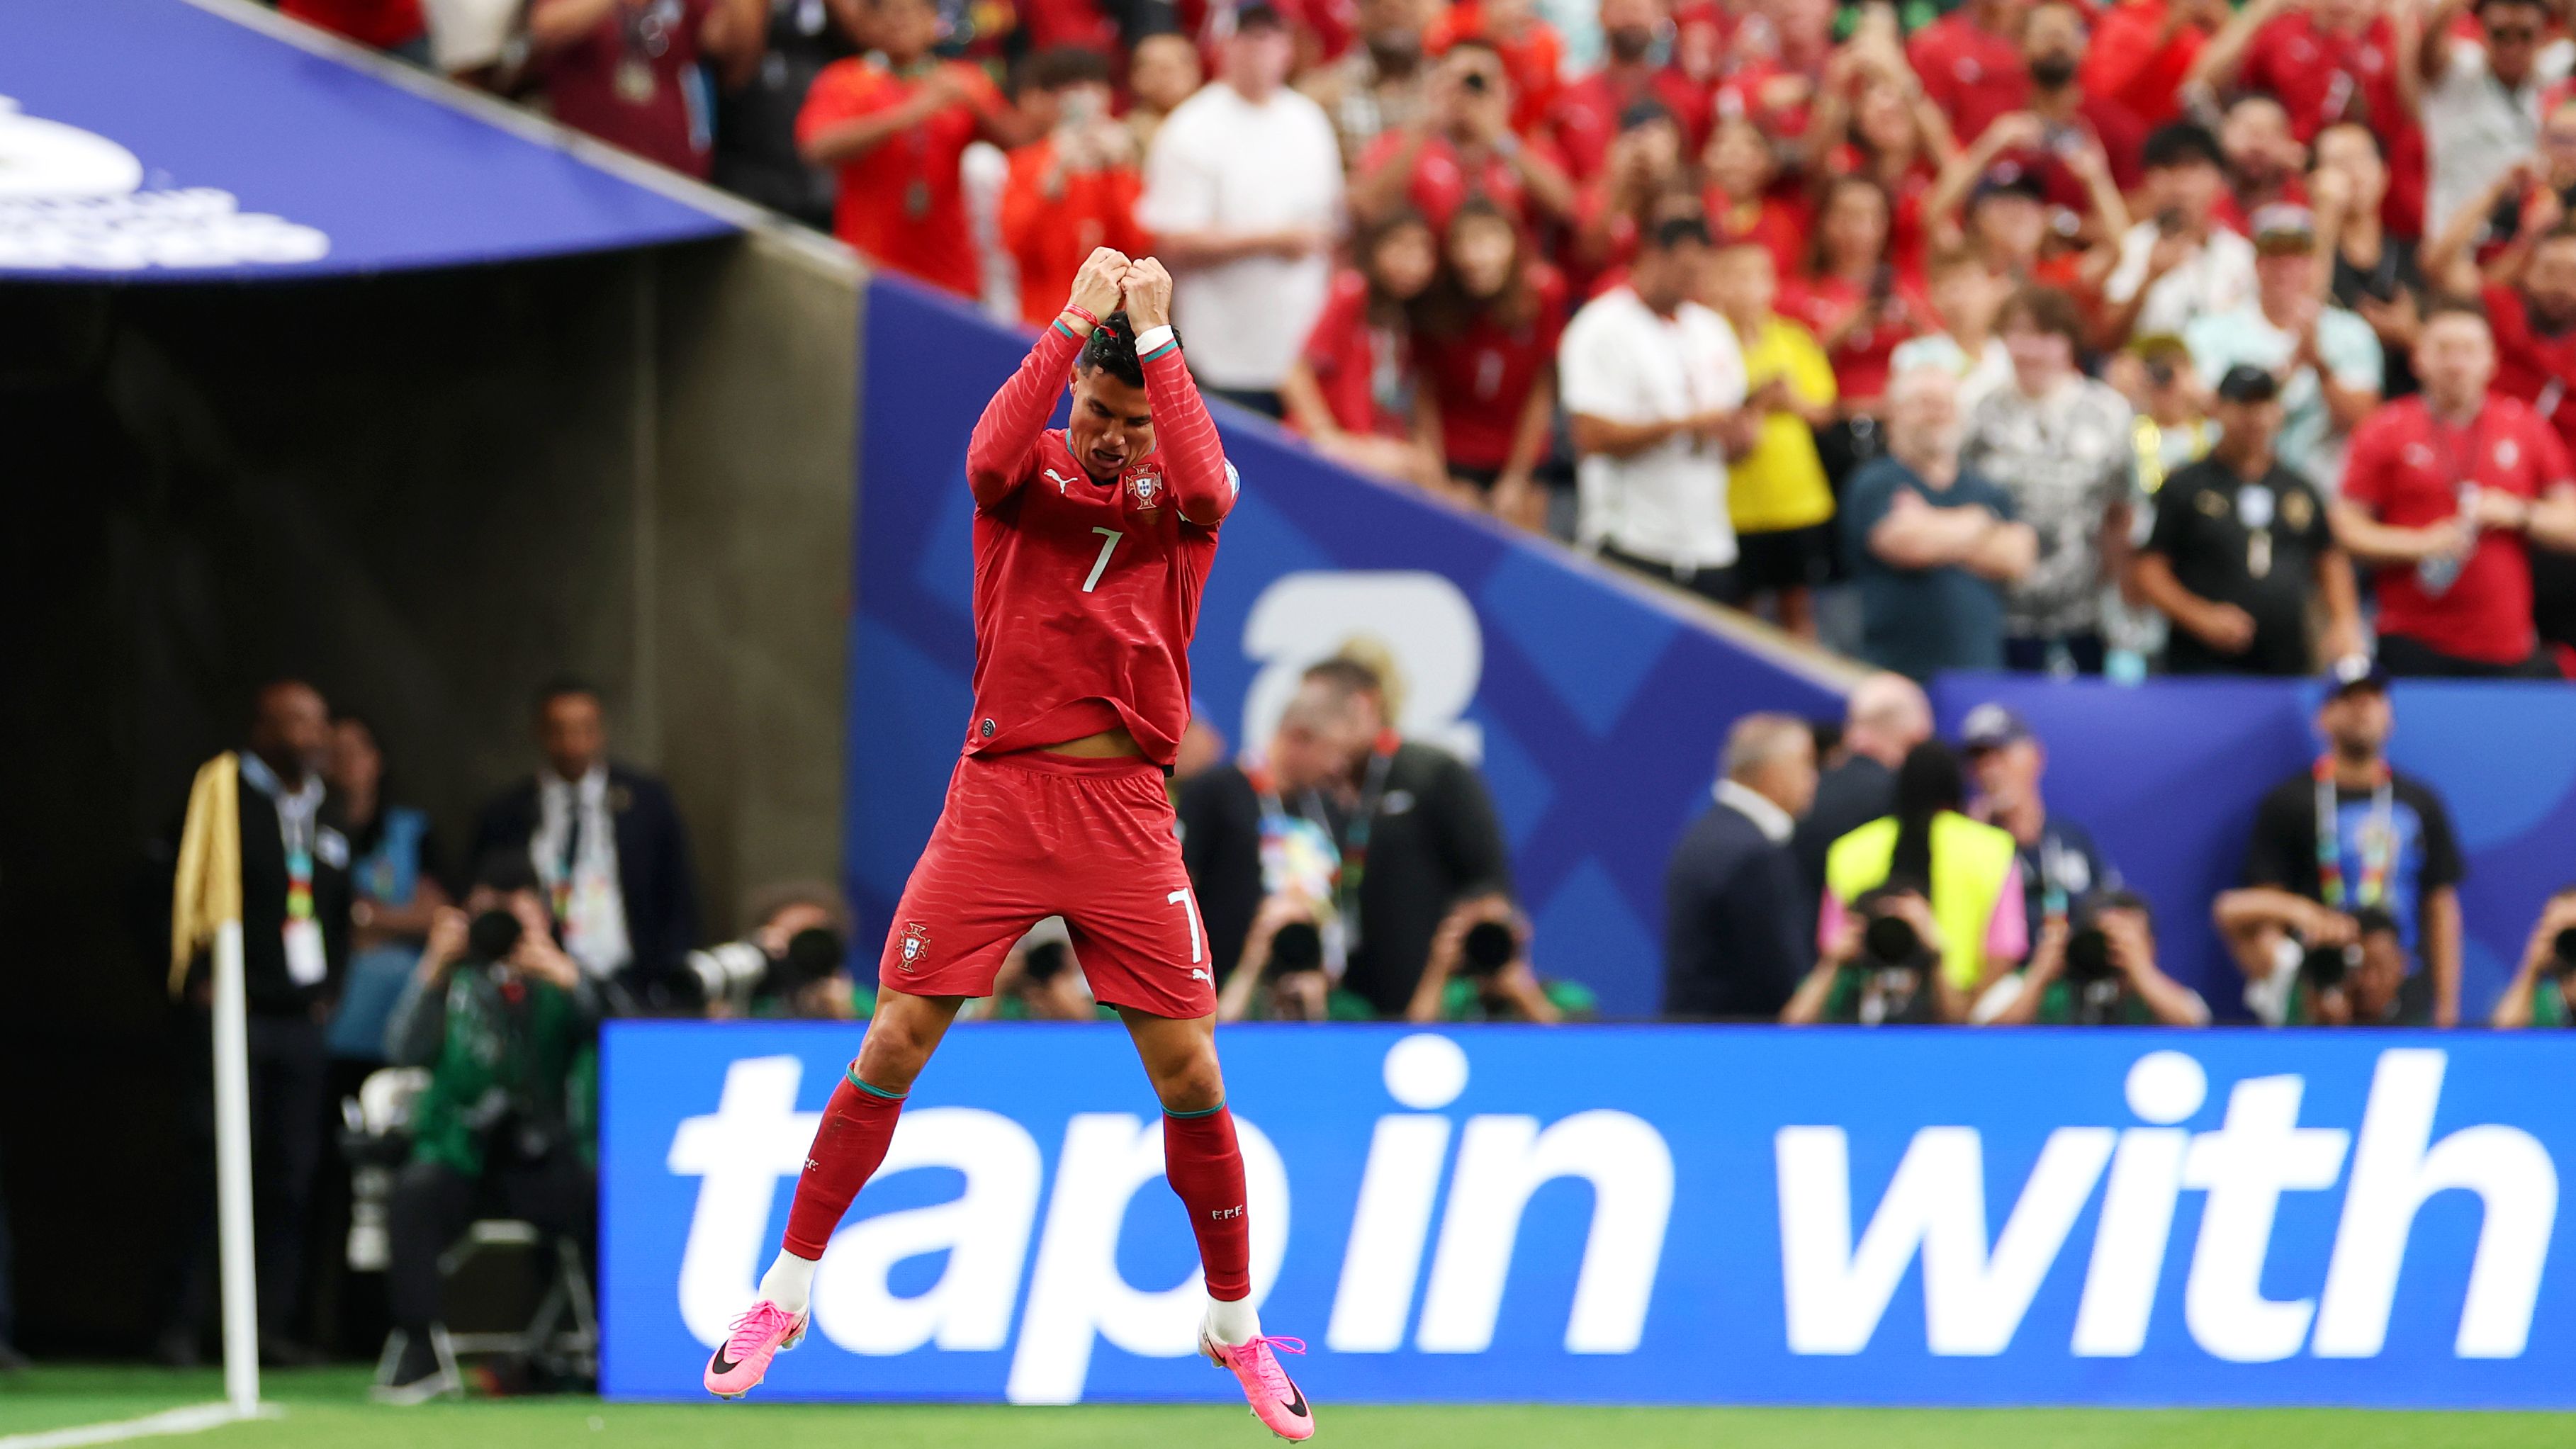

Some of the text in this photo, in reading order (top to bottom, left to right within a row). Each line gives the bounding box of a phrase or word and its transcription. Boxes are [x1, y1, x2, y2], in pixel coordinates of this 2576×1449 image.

[1082, 526, 1123, 593] 7
[1167, 887, 1202, 964] 7
[668, 1034, 2558, 1406] tap in with
